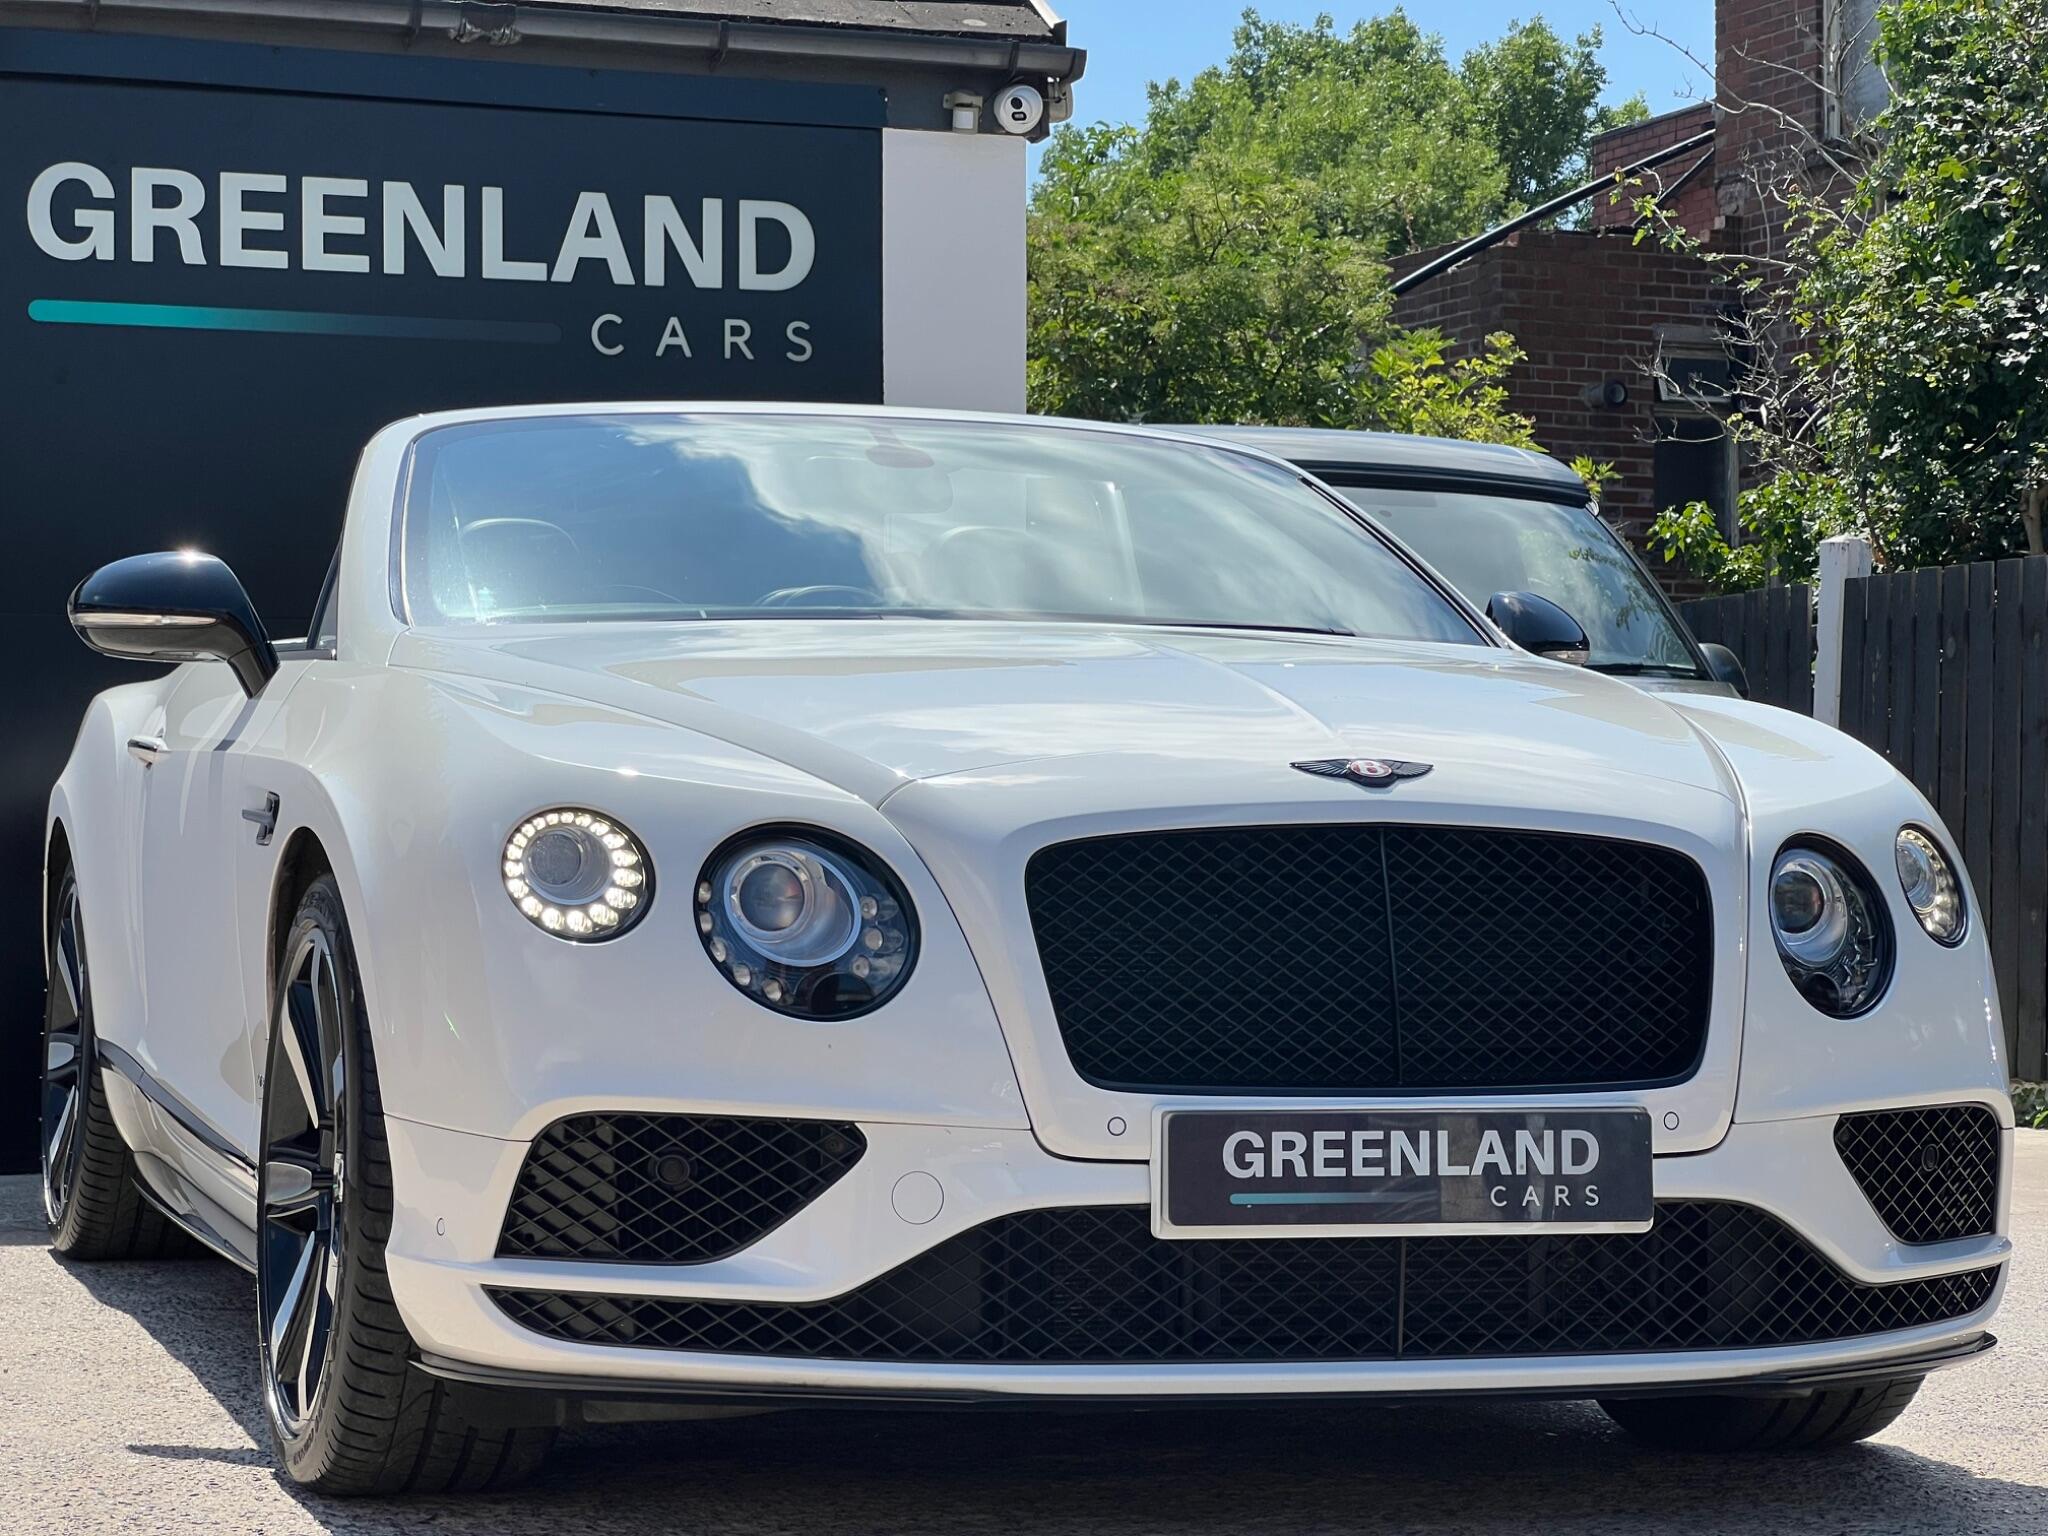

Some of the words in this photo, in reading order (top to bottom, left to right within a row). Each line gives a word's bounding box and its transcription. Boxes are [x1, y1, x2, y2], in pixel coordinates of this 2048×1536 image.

[26, 161, 816, 291] GREENLAND
[590, 313, 815, 362] CARS
[1221, 1129, 1601, 1179] GREENLAND
[1489, 1185, 1600, 1207] CARS
